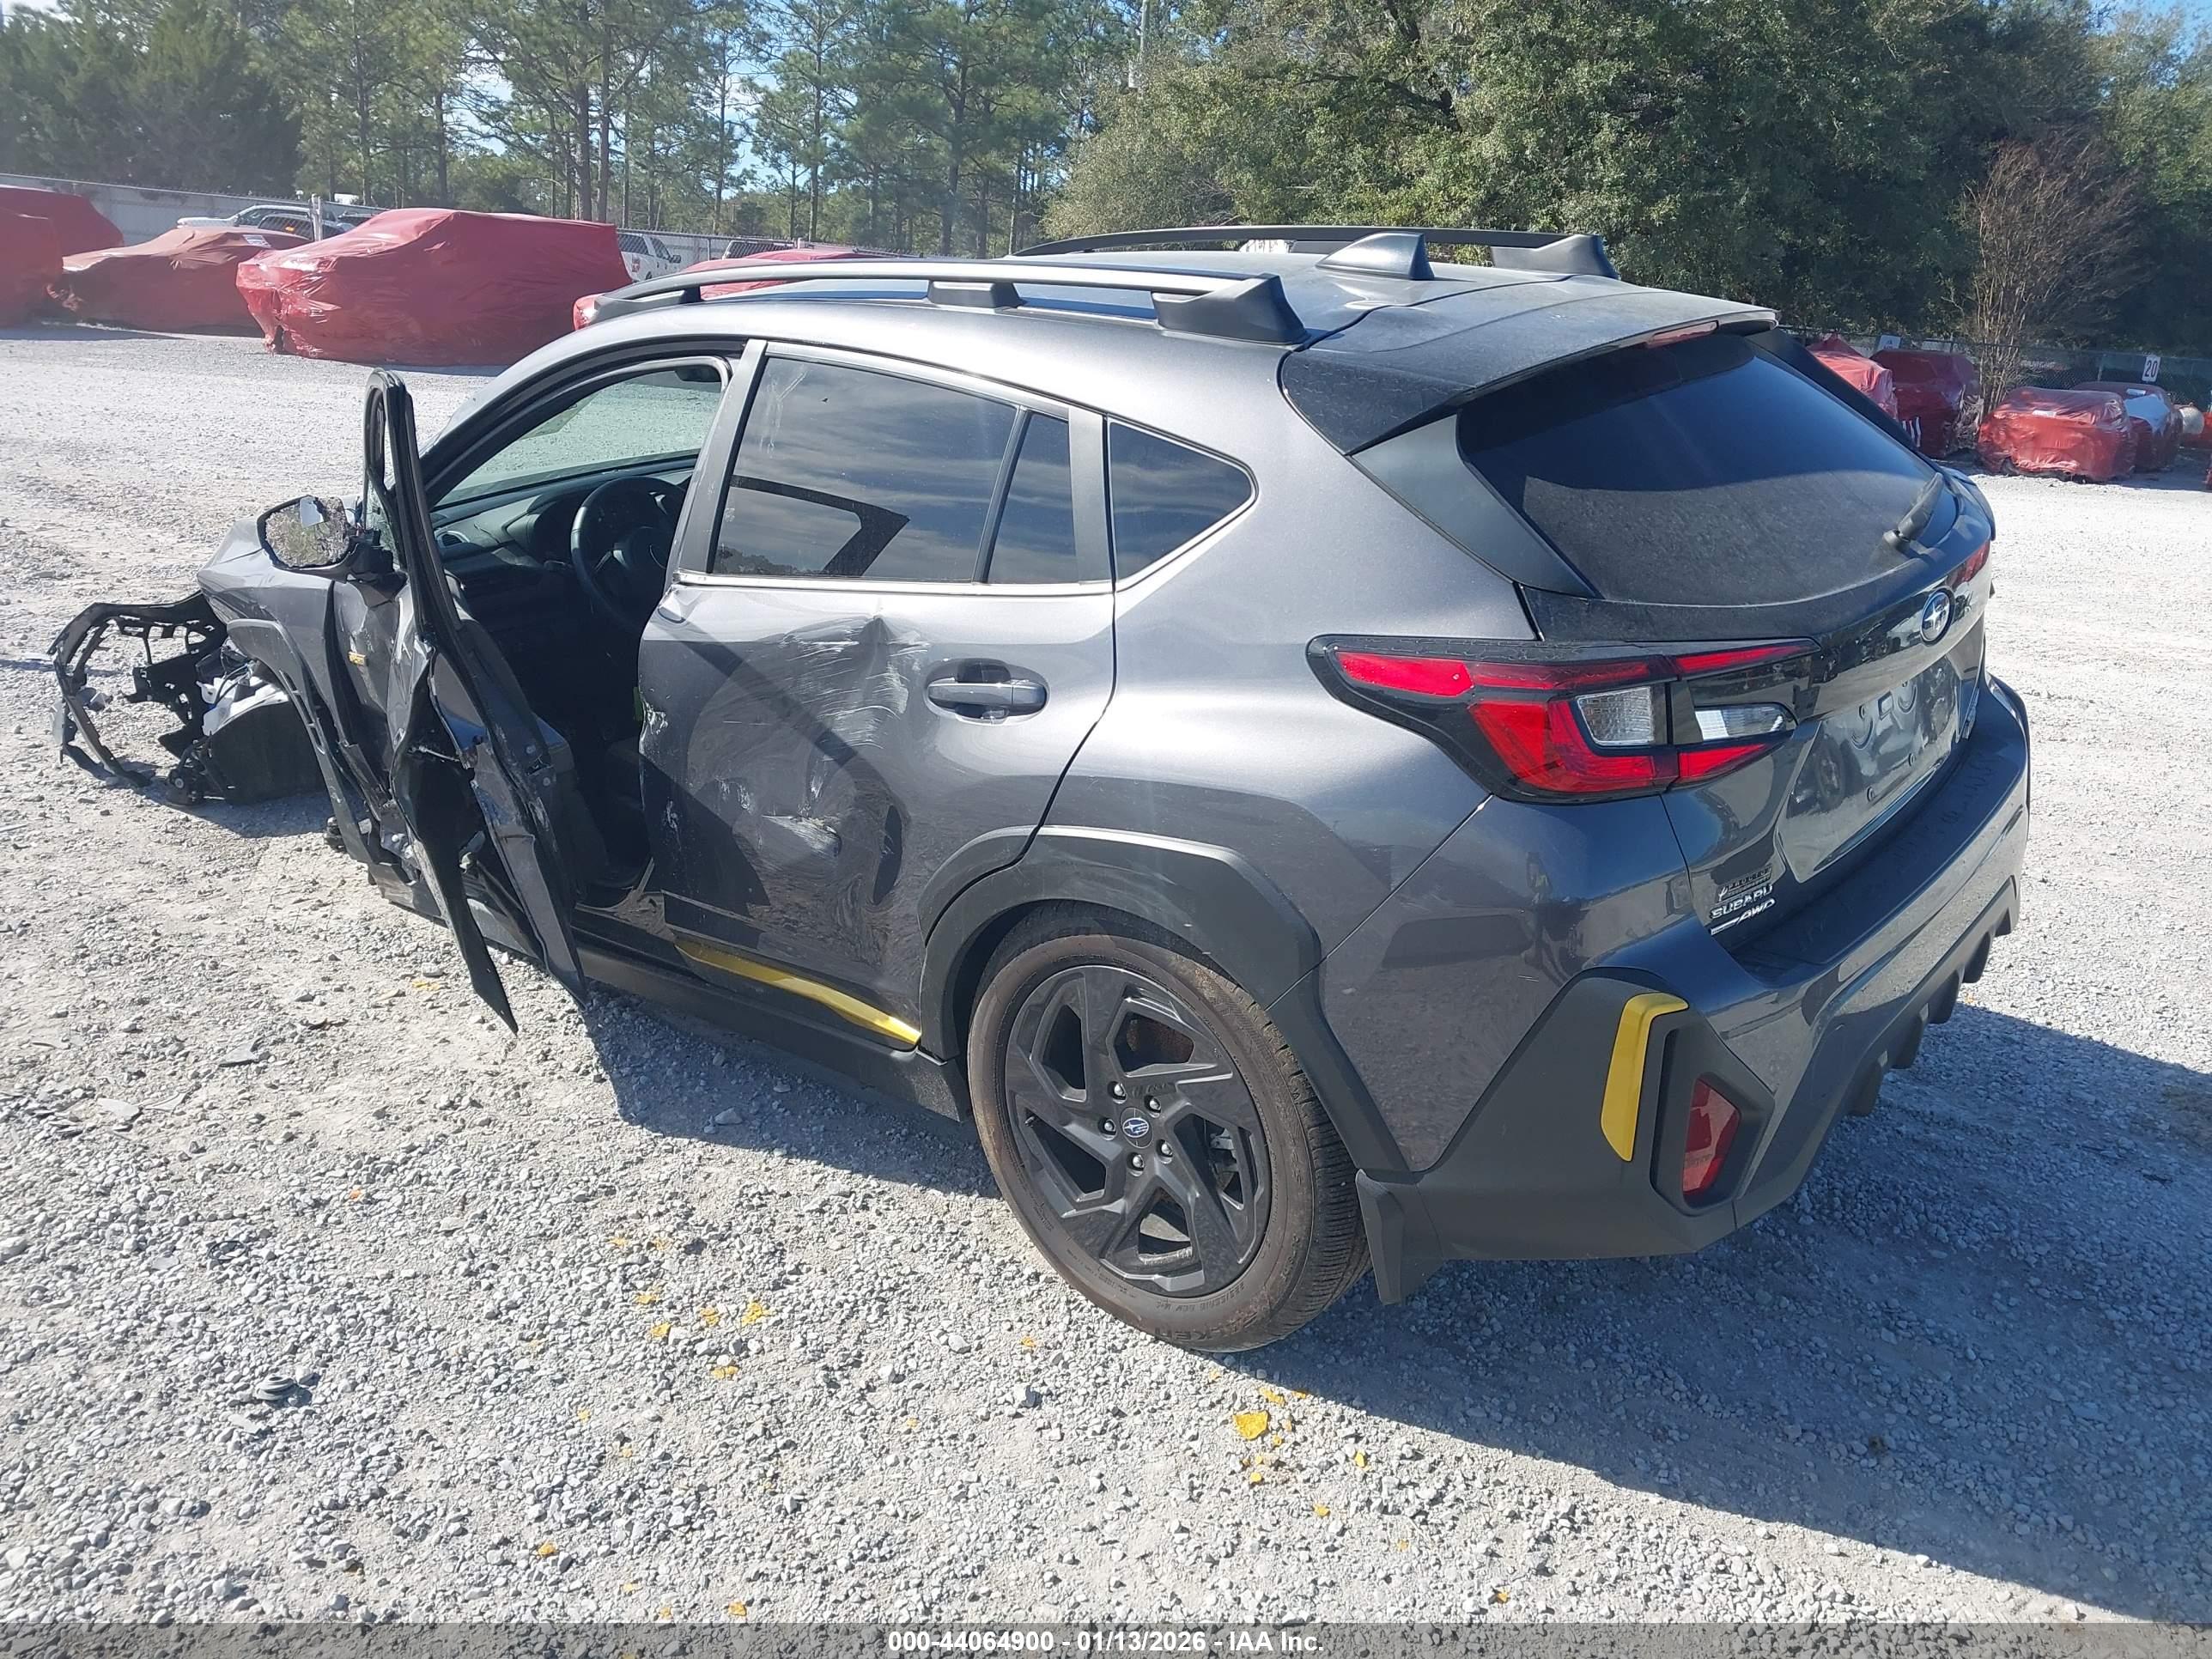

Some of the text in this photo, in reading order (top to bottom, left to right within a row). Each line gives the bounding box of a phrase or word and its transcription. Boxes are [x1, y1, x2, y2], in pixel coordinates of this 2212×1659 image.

[2144, 360, 2158, 378] 20
[1711, 884, 1773, 919] SUBARU
[1738, 898, 1776, 923] AWD
